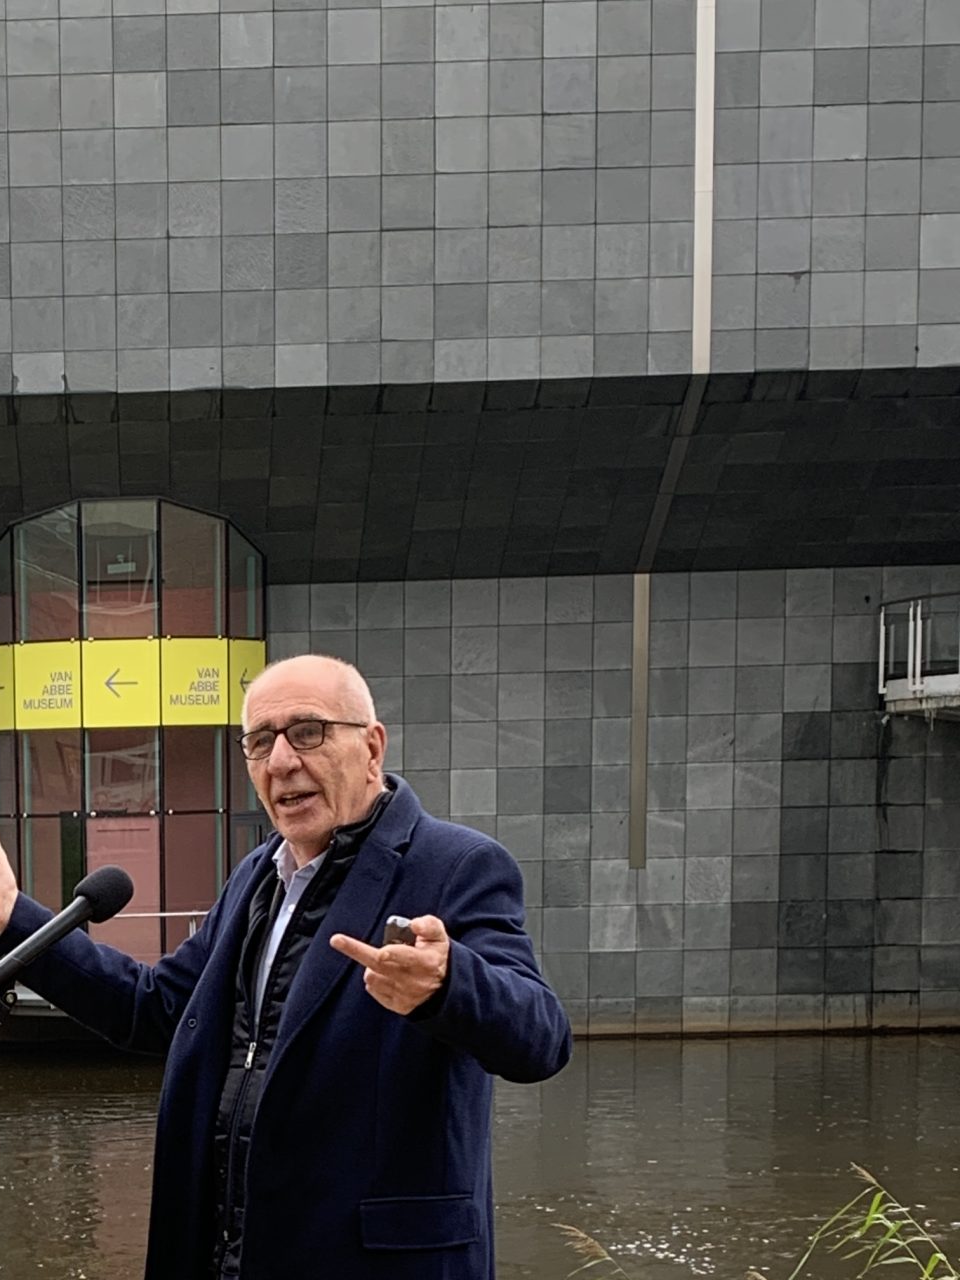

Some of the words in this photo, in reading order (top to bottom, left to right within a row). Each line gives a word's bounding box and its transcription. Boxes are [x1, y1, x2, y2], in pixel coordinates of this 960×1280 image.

[49, 671, 72, 682] VAN
[196, 668, 220, 679] VAN
[42, 684, 73, 696] ABBE
[189, 681, 220, 692] ABBE
[23, 698, 73, 710] MUSEUM
[169, 694, 220, 705] MUSEUM
